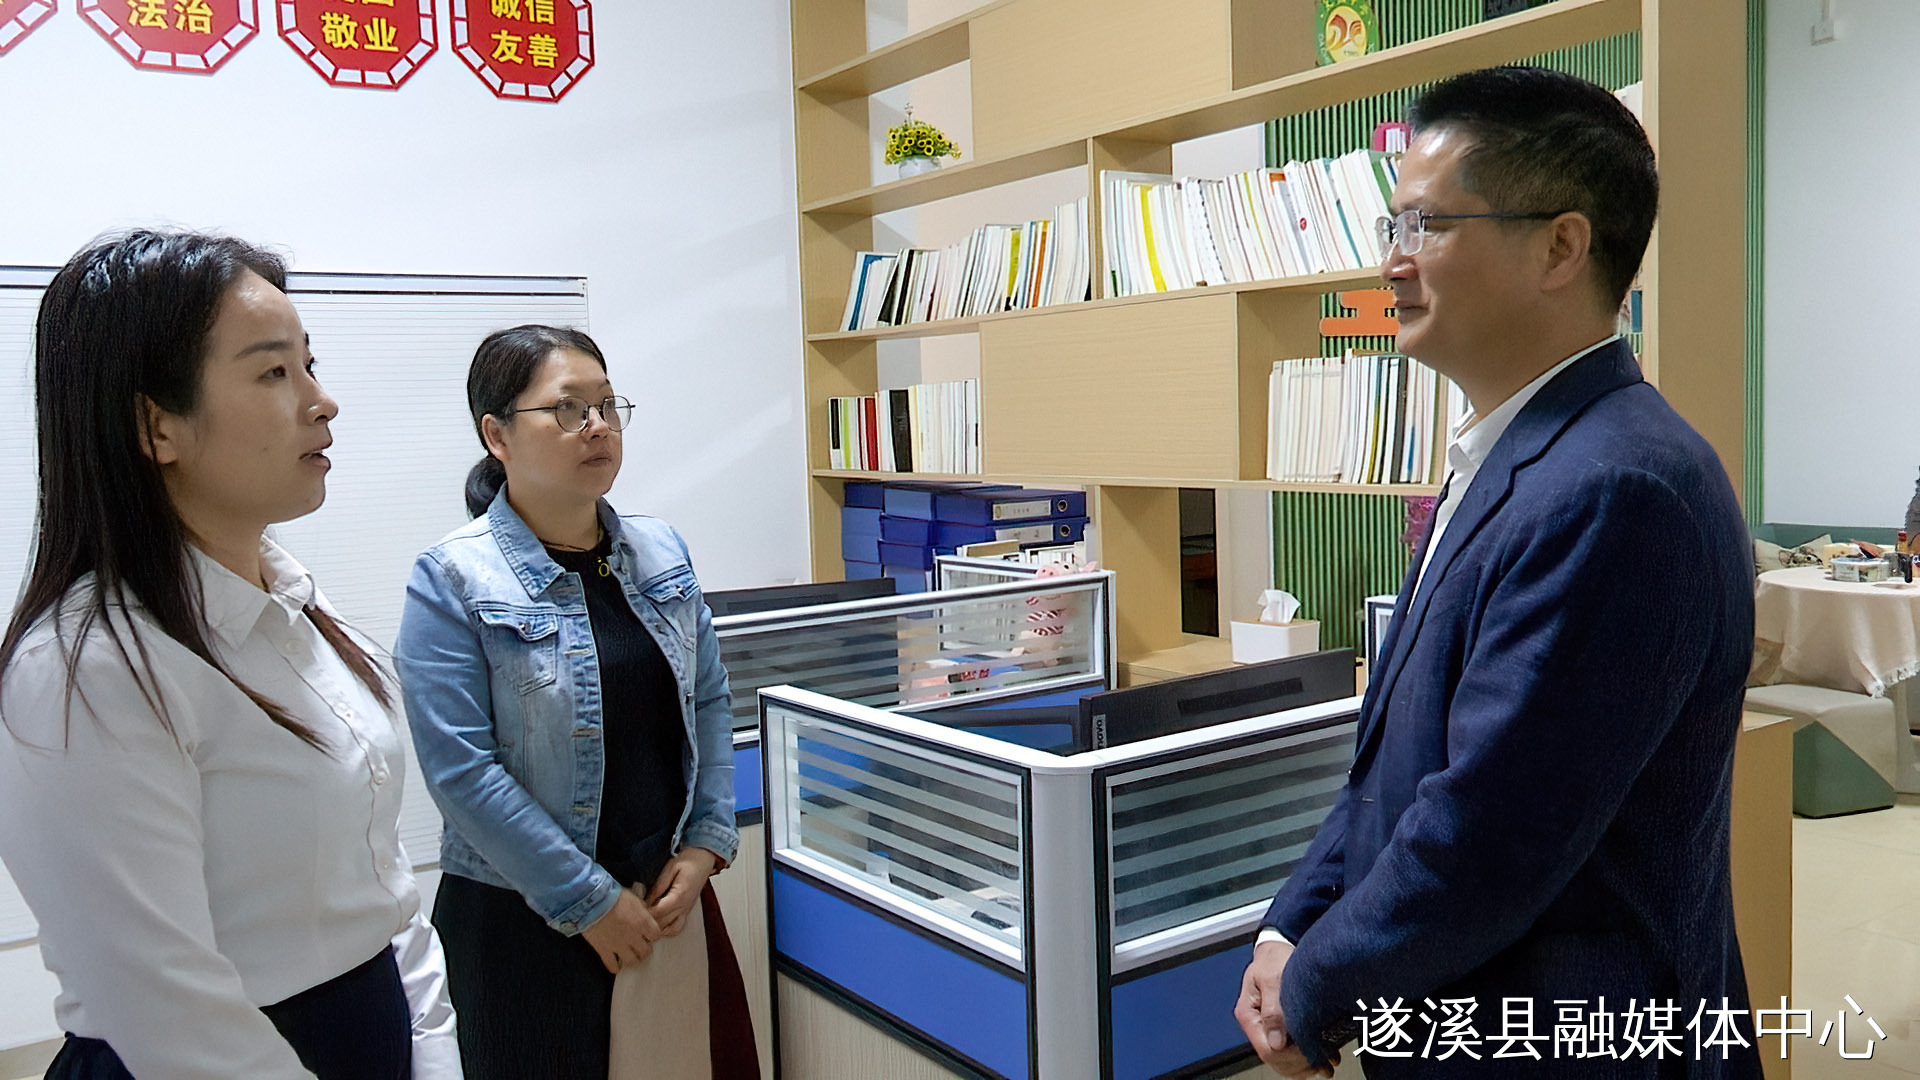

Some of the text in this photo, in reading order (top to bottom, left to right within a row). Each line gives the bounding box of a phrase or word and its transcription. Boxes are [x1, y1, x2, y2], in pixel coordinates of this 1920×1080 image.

[127, 0, 214, 34] 法治
[320, 12, 399, 52] 敬业
[491, 30, 558, 68] 友善
